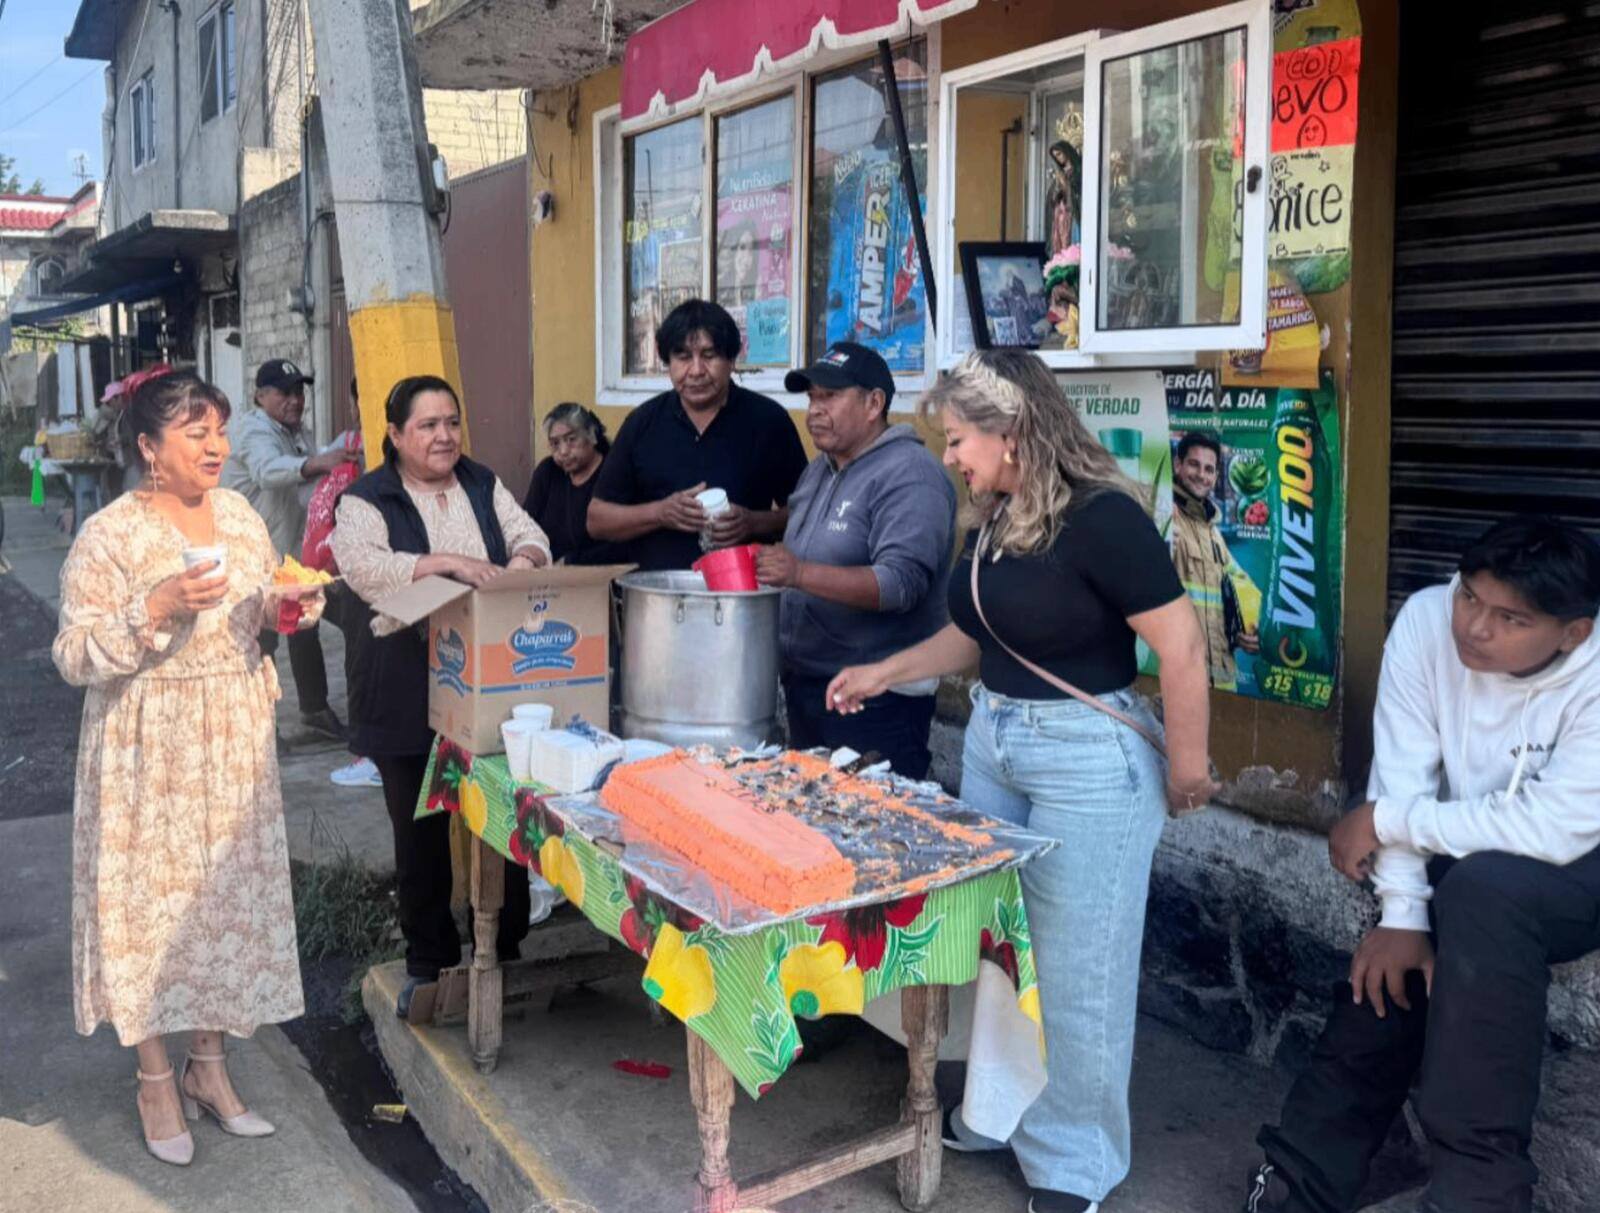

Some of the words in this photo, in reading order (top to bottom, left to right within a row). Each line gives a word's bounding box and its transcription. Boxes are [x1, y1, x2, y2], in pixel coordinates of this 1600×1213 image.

[1268, 182, 1343, 233] nice
[860, 191, 890, 331] AMPER
[1086, 397, 1141, 415] VERDAD
[1185, 388, 1215, 408] DÍA
[1220, 392, 1233, 408] A
[1237, 388, 1267, 408] DÍA
[1223, 417, 1268, 428] NATURALES
